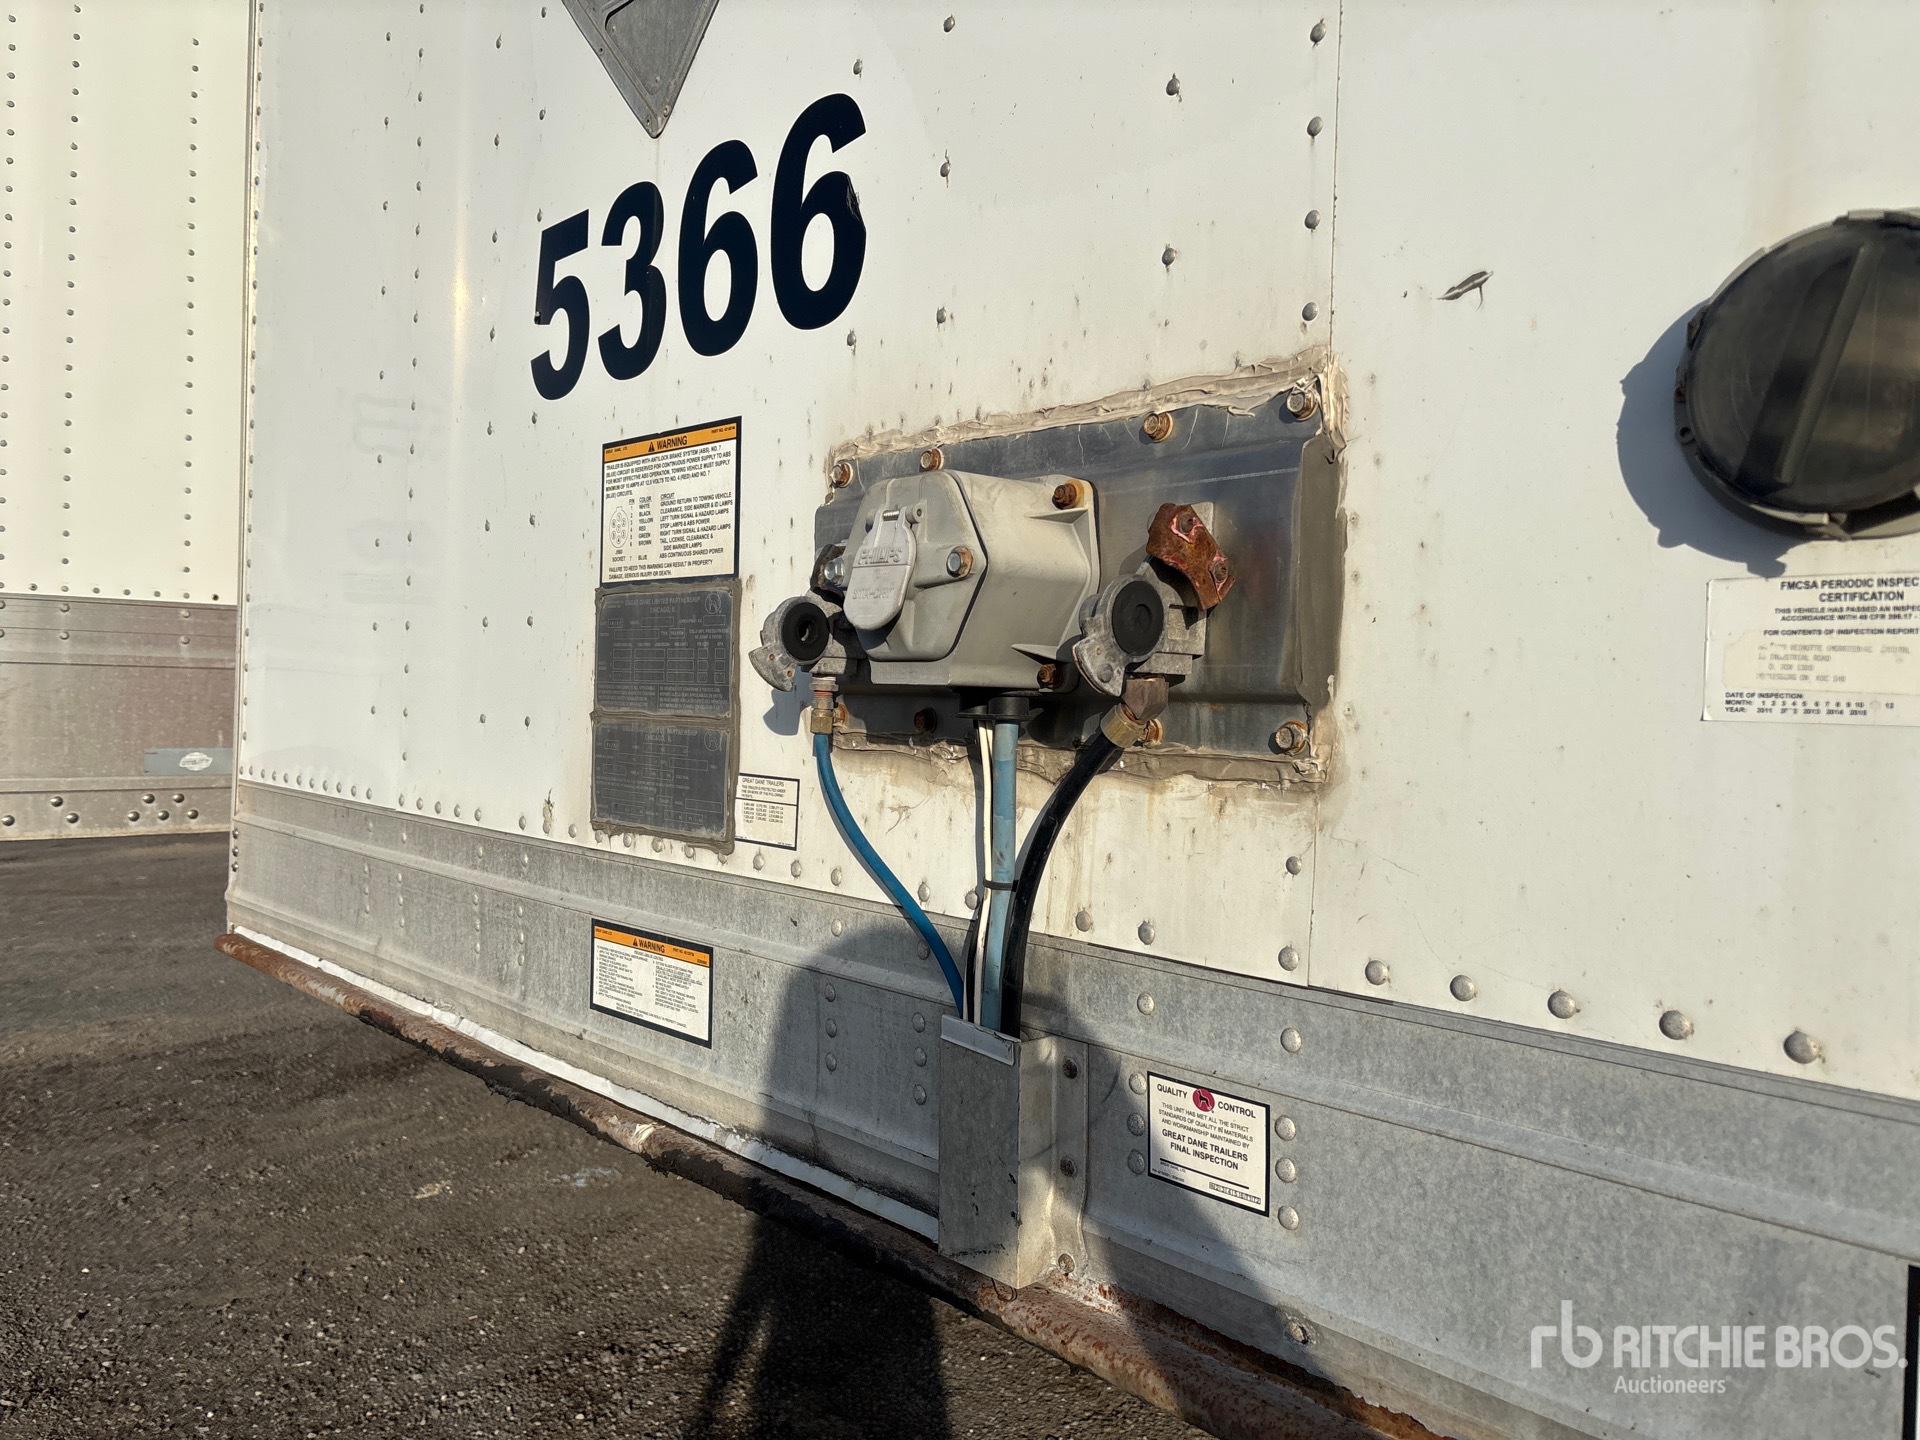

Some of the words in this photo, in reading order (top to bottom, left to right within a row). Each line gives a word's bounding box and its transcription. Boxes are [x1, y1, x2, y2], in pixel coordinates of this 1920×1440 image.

[530, 93, 866, 400] 5366
[657, 435, 687, 450] WARNING
[1780, 580, 1818, 590] FMCSA
[1821, 578, 1874, 589] PERIODIC
[1819, 591, 1904, 602] CERTIFICATION
[639, 938, 666, 953] WARNING
[1156, 1084, 1188, 1098] QUALITY
[1218, 1101, 1256, 1118] CONTROL
[1159, 1109, 1186, 1122] STANDARDS
[1195, 1120, 1216, 1130] QUALITY
[1224, 1128, 1253, 1142] MATERIALS
[1173, 1122, 1209, 1136] WORKMANSHIP
[1210, 1132, 1240, 1146] MAINTAINED
[1197, 1112, 1207, 1120] MET
[1218, 1118, 1228, 1126] THE
[1230, 1122, 1248, 1132] STRICT
[1162, 1128, 1186, 1142] GREAT
[1188, 1136, 1208, 1150] DANE
[1210, 1143, 1248, 1162] TRAILERS
[1170, 1142, 1190, 1156] FINAL
[1193, 1149, 1238, 1170] INSPECTION
